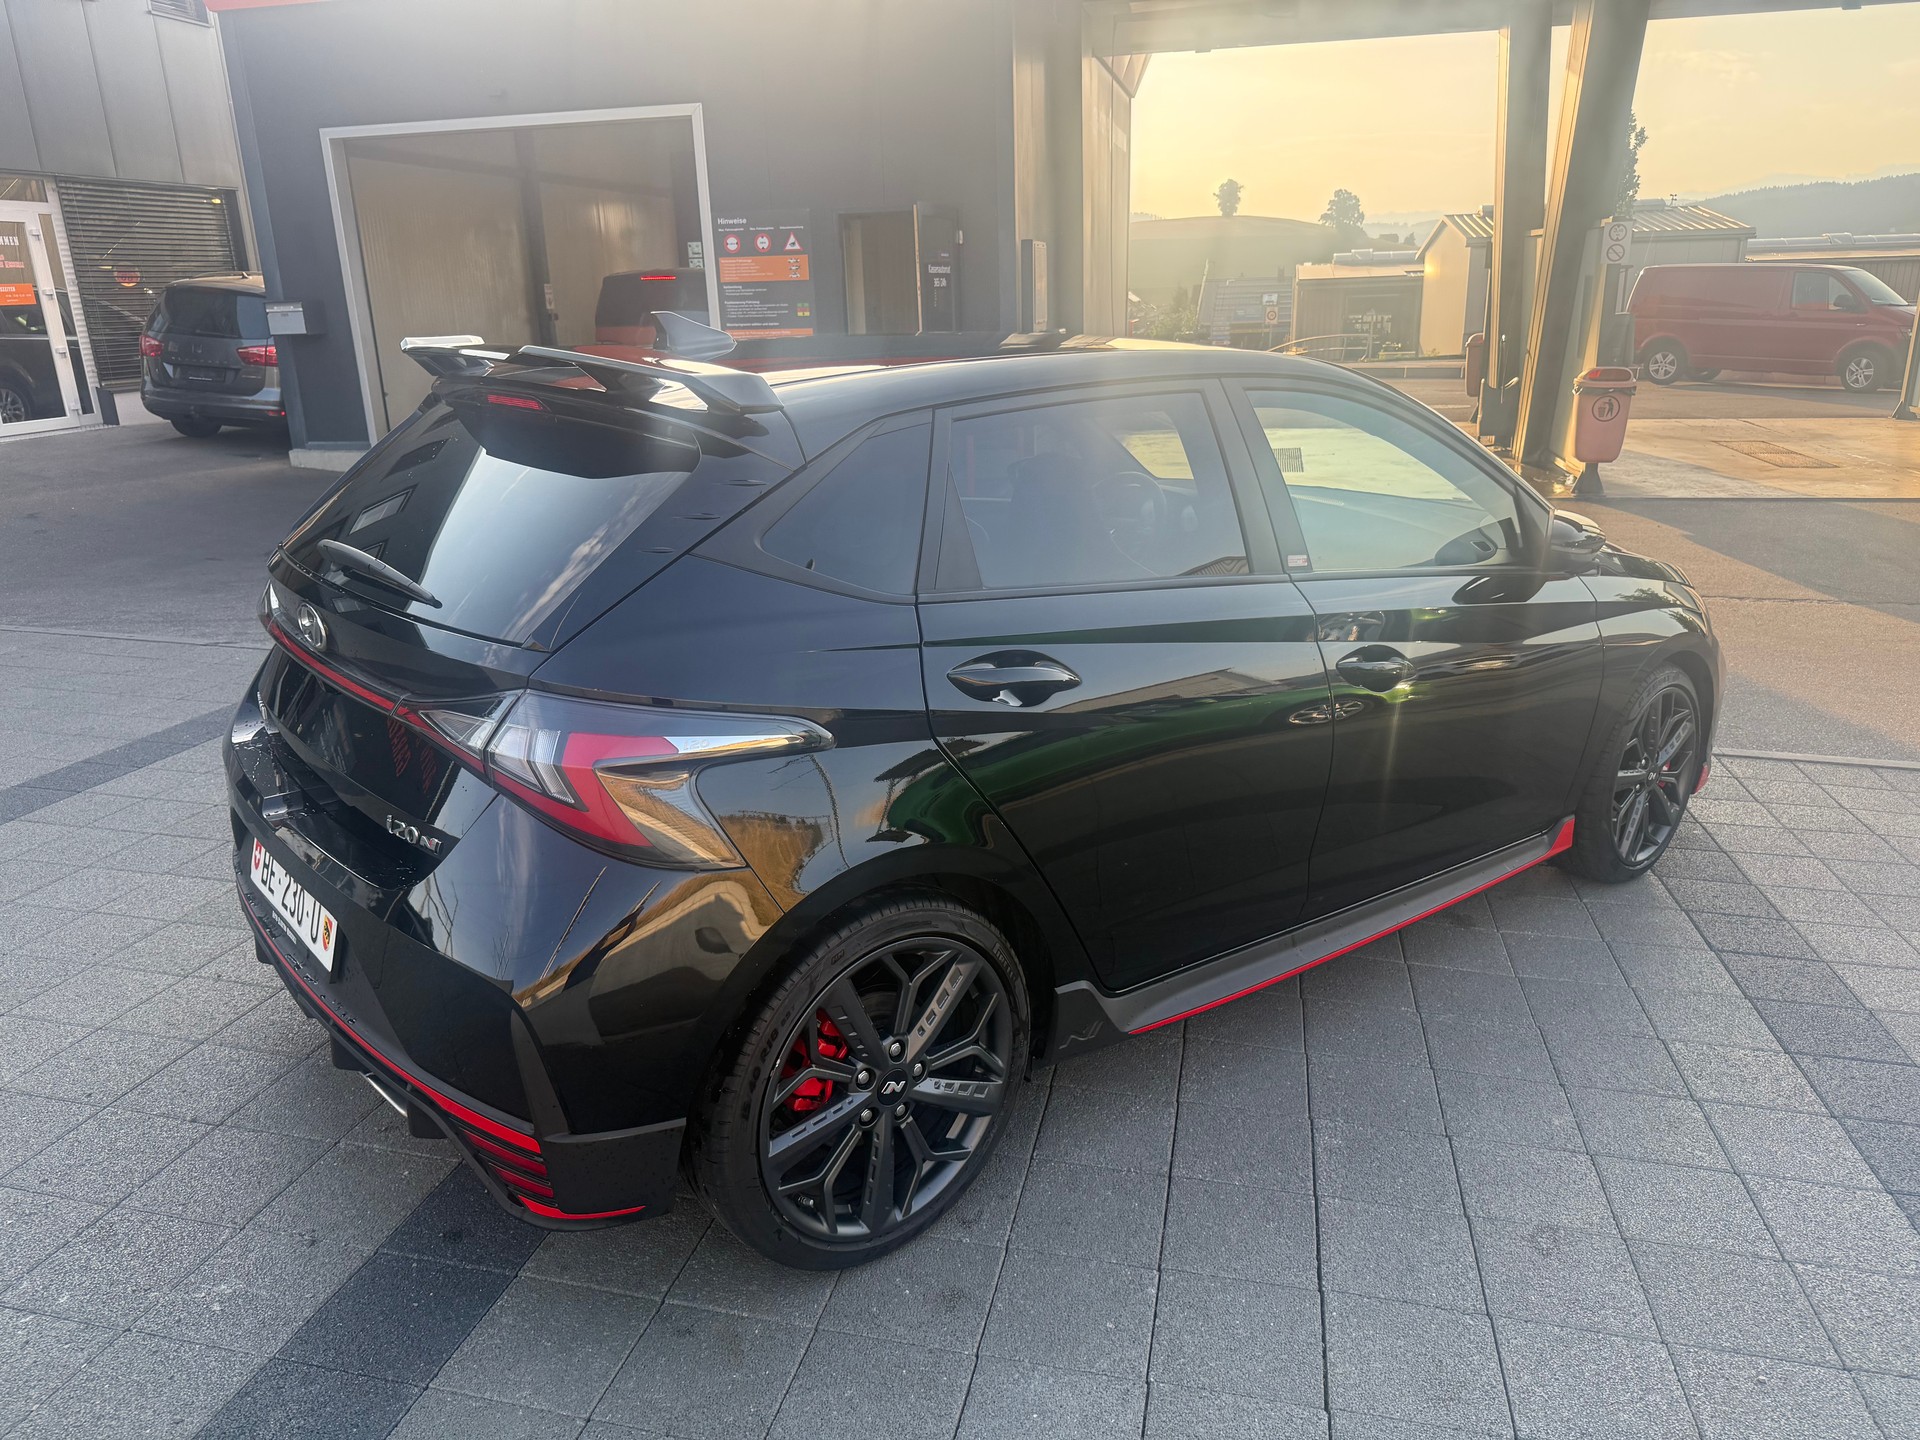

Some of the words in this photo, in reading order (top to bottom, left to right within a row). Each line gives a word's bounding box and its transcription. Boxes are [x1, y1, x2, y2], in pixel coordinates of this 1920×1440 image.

[717, 217, 747, 225] Hinweise
[387, 814, 419, 844] i20
[881, 1081, 906, 1095] N
